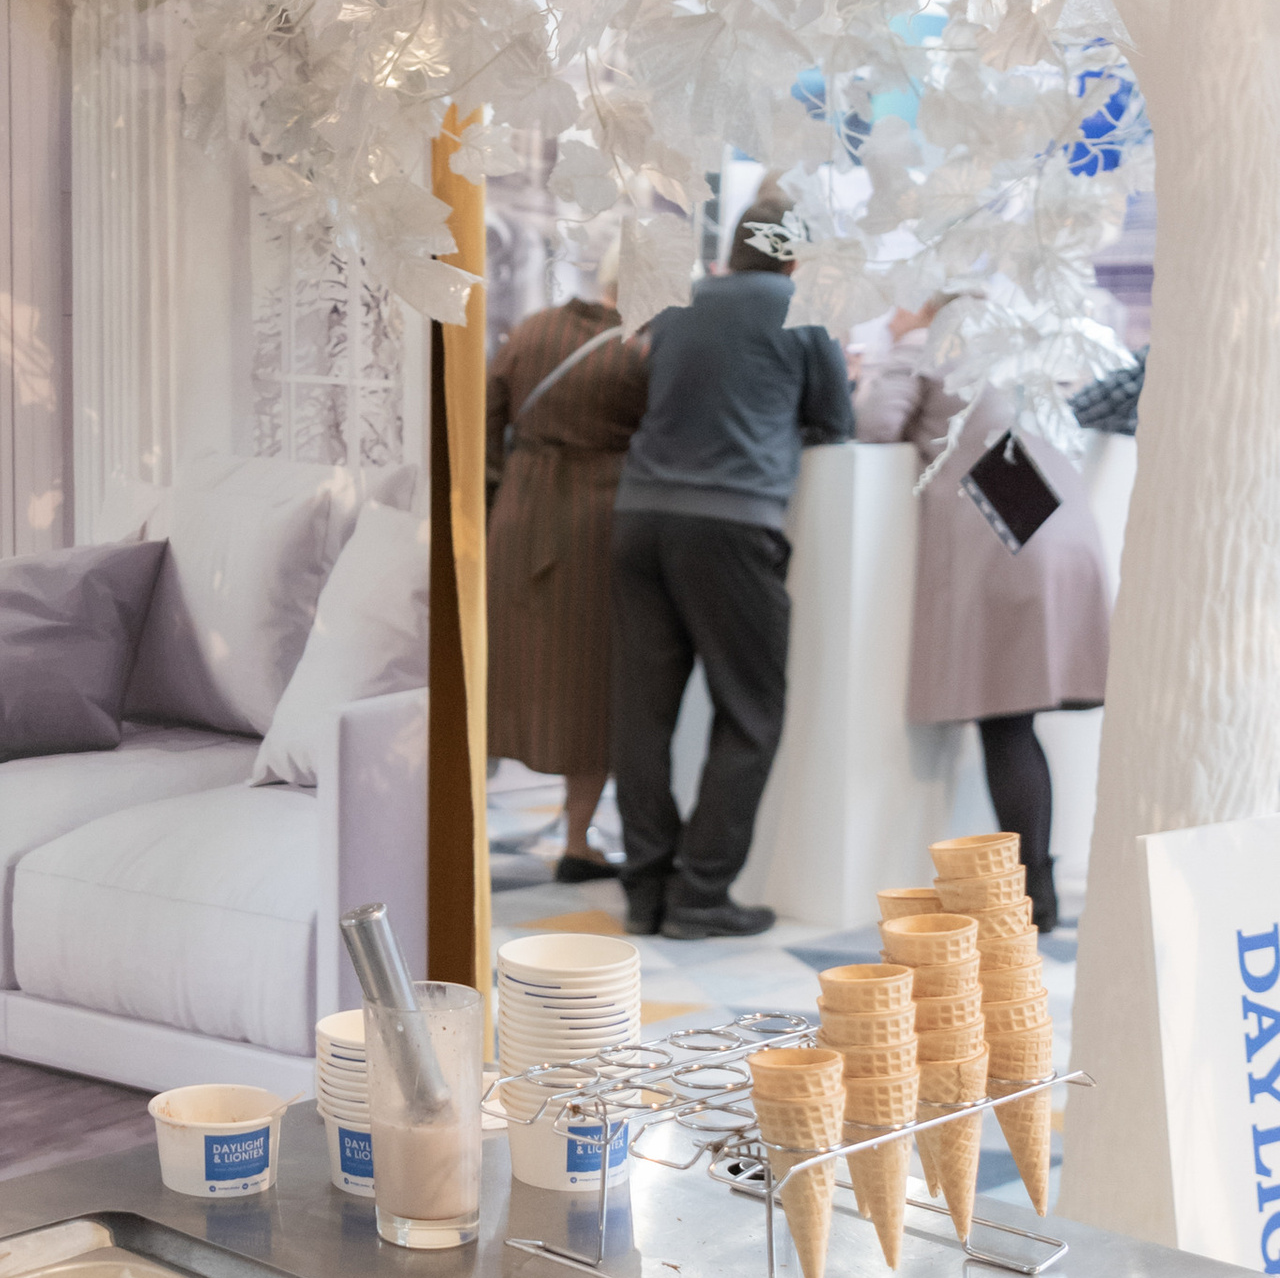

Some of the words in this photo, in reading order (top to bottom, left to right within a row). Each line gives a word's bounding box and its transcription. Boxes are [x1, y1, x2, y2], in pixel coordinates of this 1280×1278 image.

[212, 1136, 265, 1154] DAYLIGHT
[587, 1139, 625, 1155] LIOTEX
[224, 1148, 265, 1163] LIONTEX
